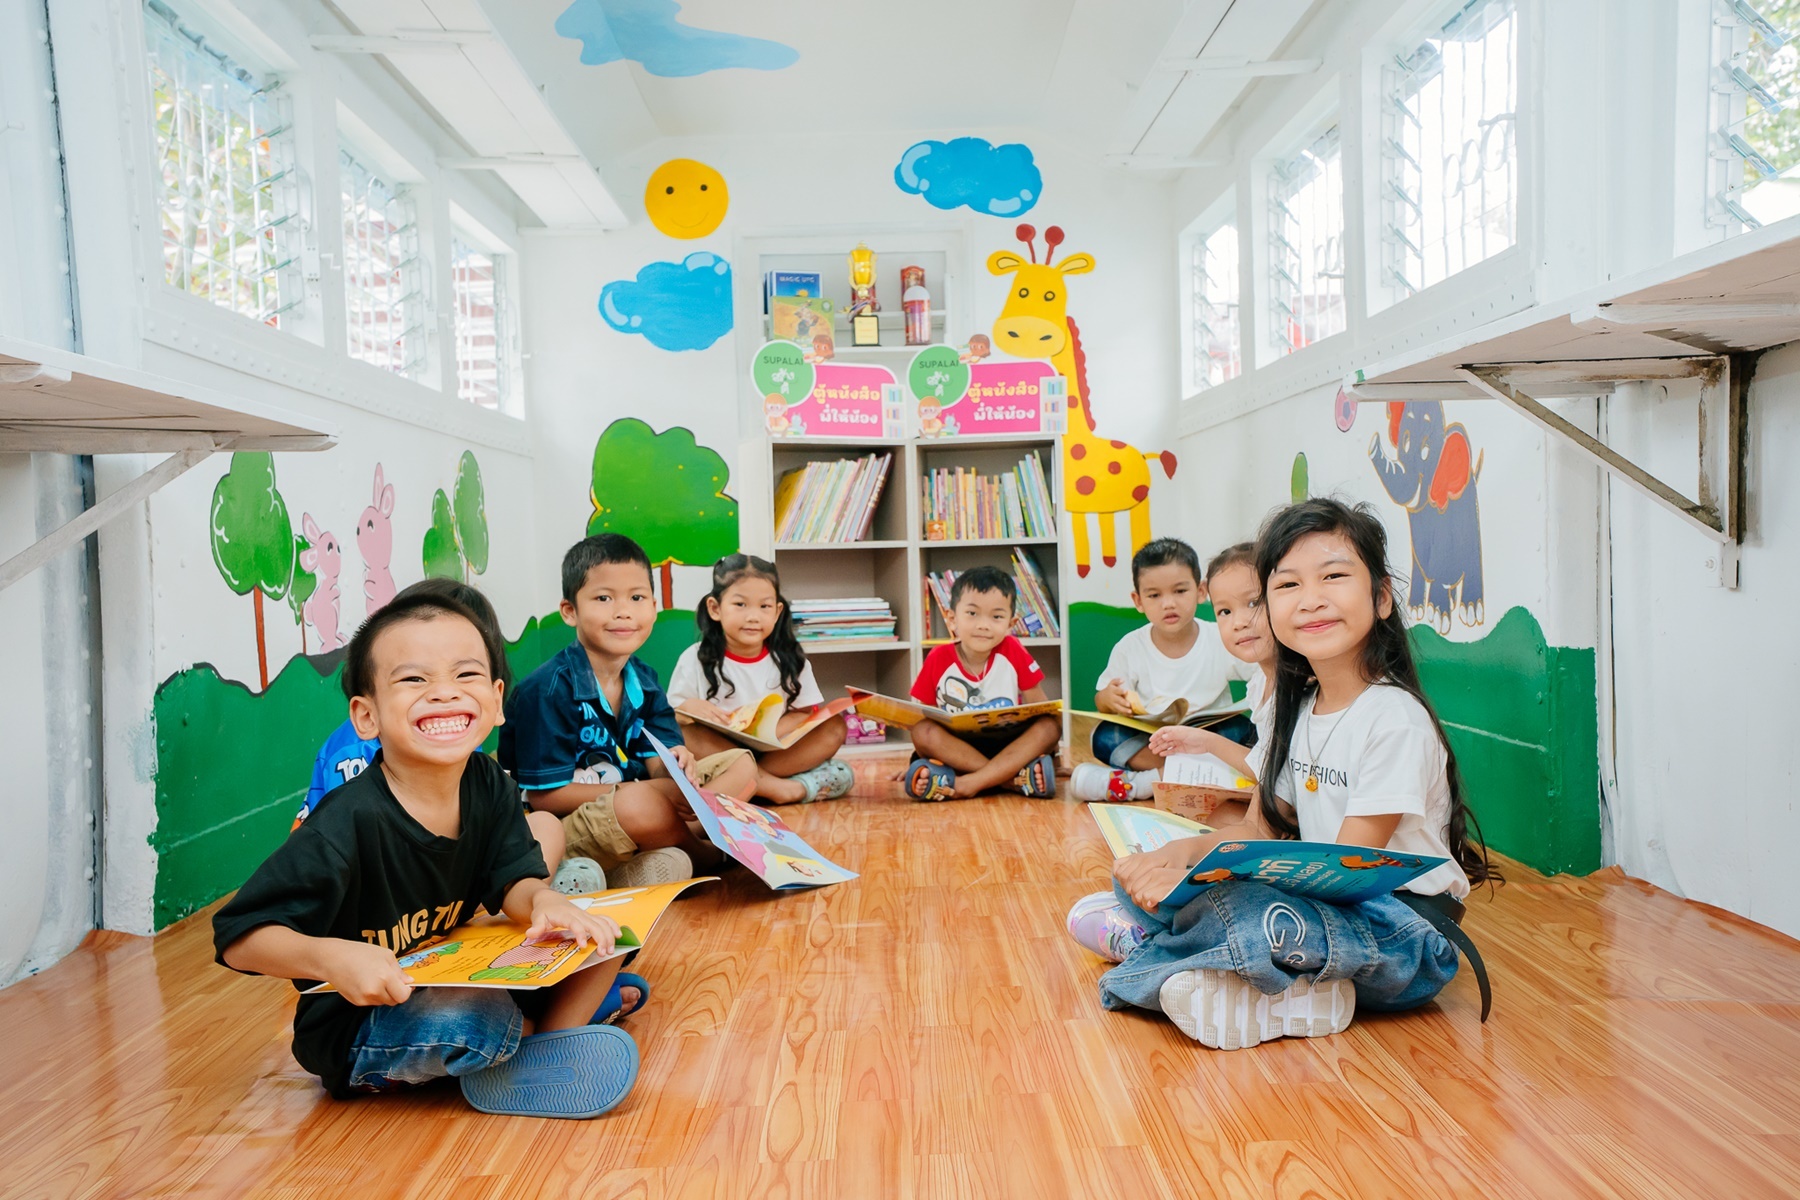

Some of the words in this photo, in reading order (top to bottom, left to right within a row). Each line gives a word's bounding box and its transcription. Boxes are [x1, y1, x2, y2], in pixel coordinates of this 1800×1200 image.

[919, 359, 959, 369] SUPALAI
[812, 383, 881, 405] ตู้หนังสือ
[967, 380, 1039, 404] ตู้หนังสือ
[819, 403, 878, 425] พี่ให้น้อง
[973, 401, 1036, 421] พี่ให้น้อง
